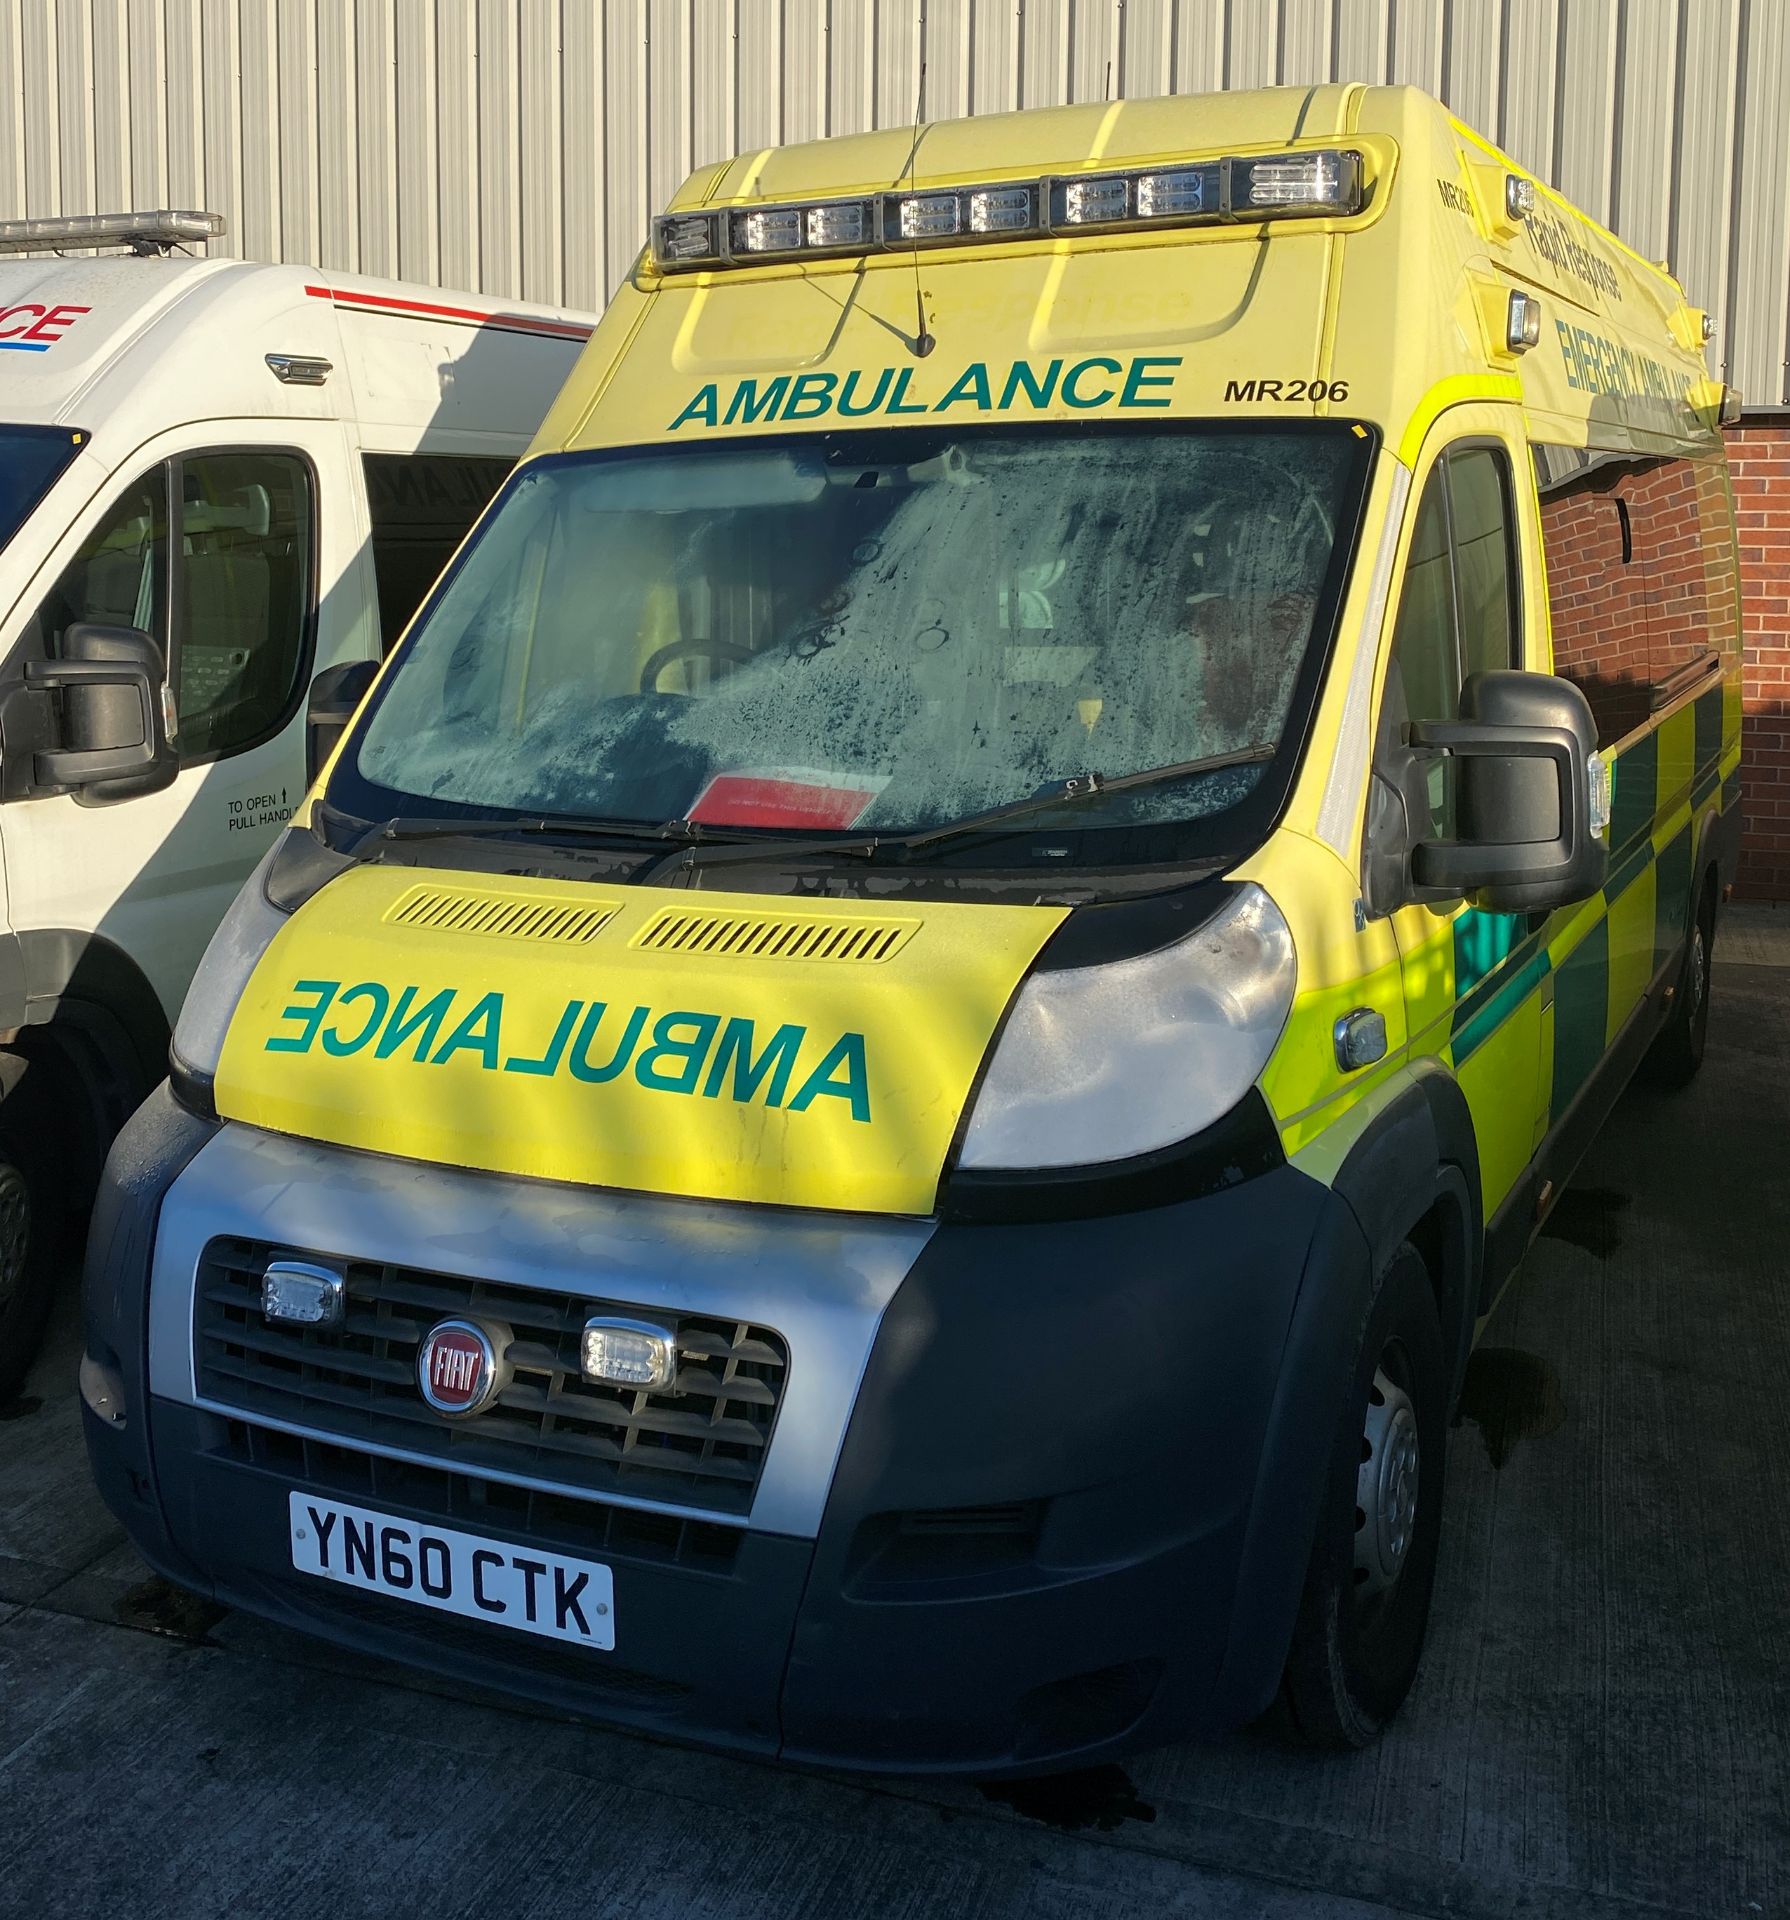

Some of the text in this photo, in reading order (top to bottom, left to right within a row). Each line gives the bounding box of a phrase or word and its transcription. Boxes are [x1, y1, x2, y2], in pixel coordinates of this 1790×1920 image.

[1435, 178, 1475, 218] MR206
[1524, 209, 1622, 301] Rapid Response
[0, 304, 93, 341] CE
[1554, 318, 1643, 406] EMERGENCY
[666, 356, 1185, 431] AMBULANCE
[1223, 379, 1350, 402] MR206
[228, 794, 276, 814] TO OPEN
[229, 815, 256, 831] PULL
[433, 1345, 479, 1392] FIAT
[306, 1505, 592, 1636] YN60 CTK
